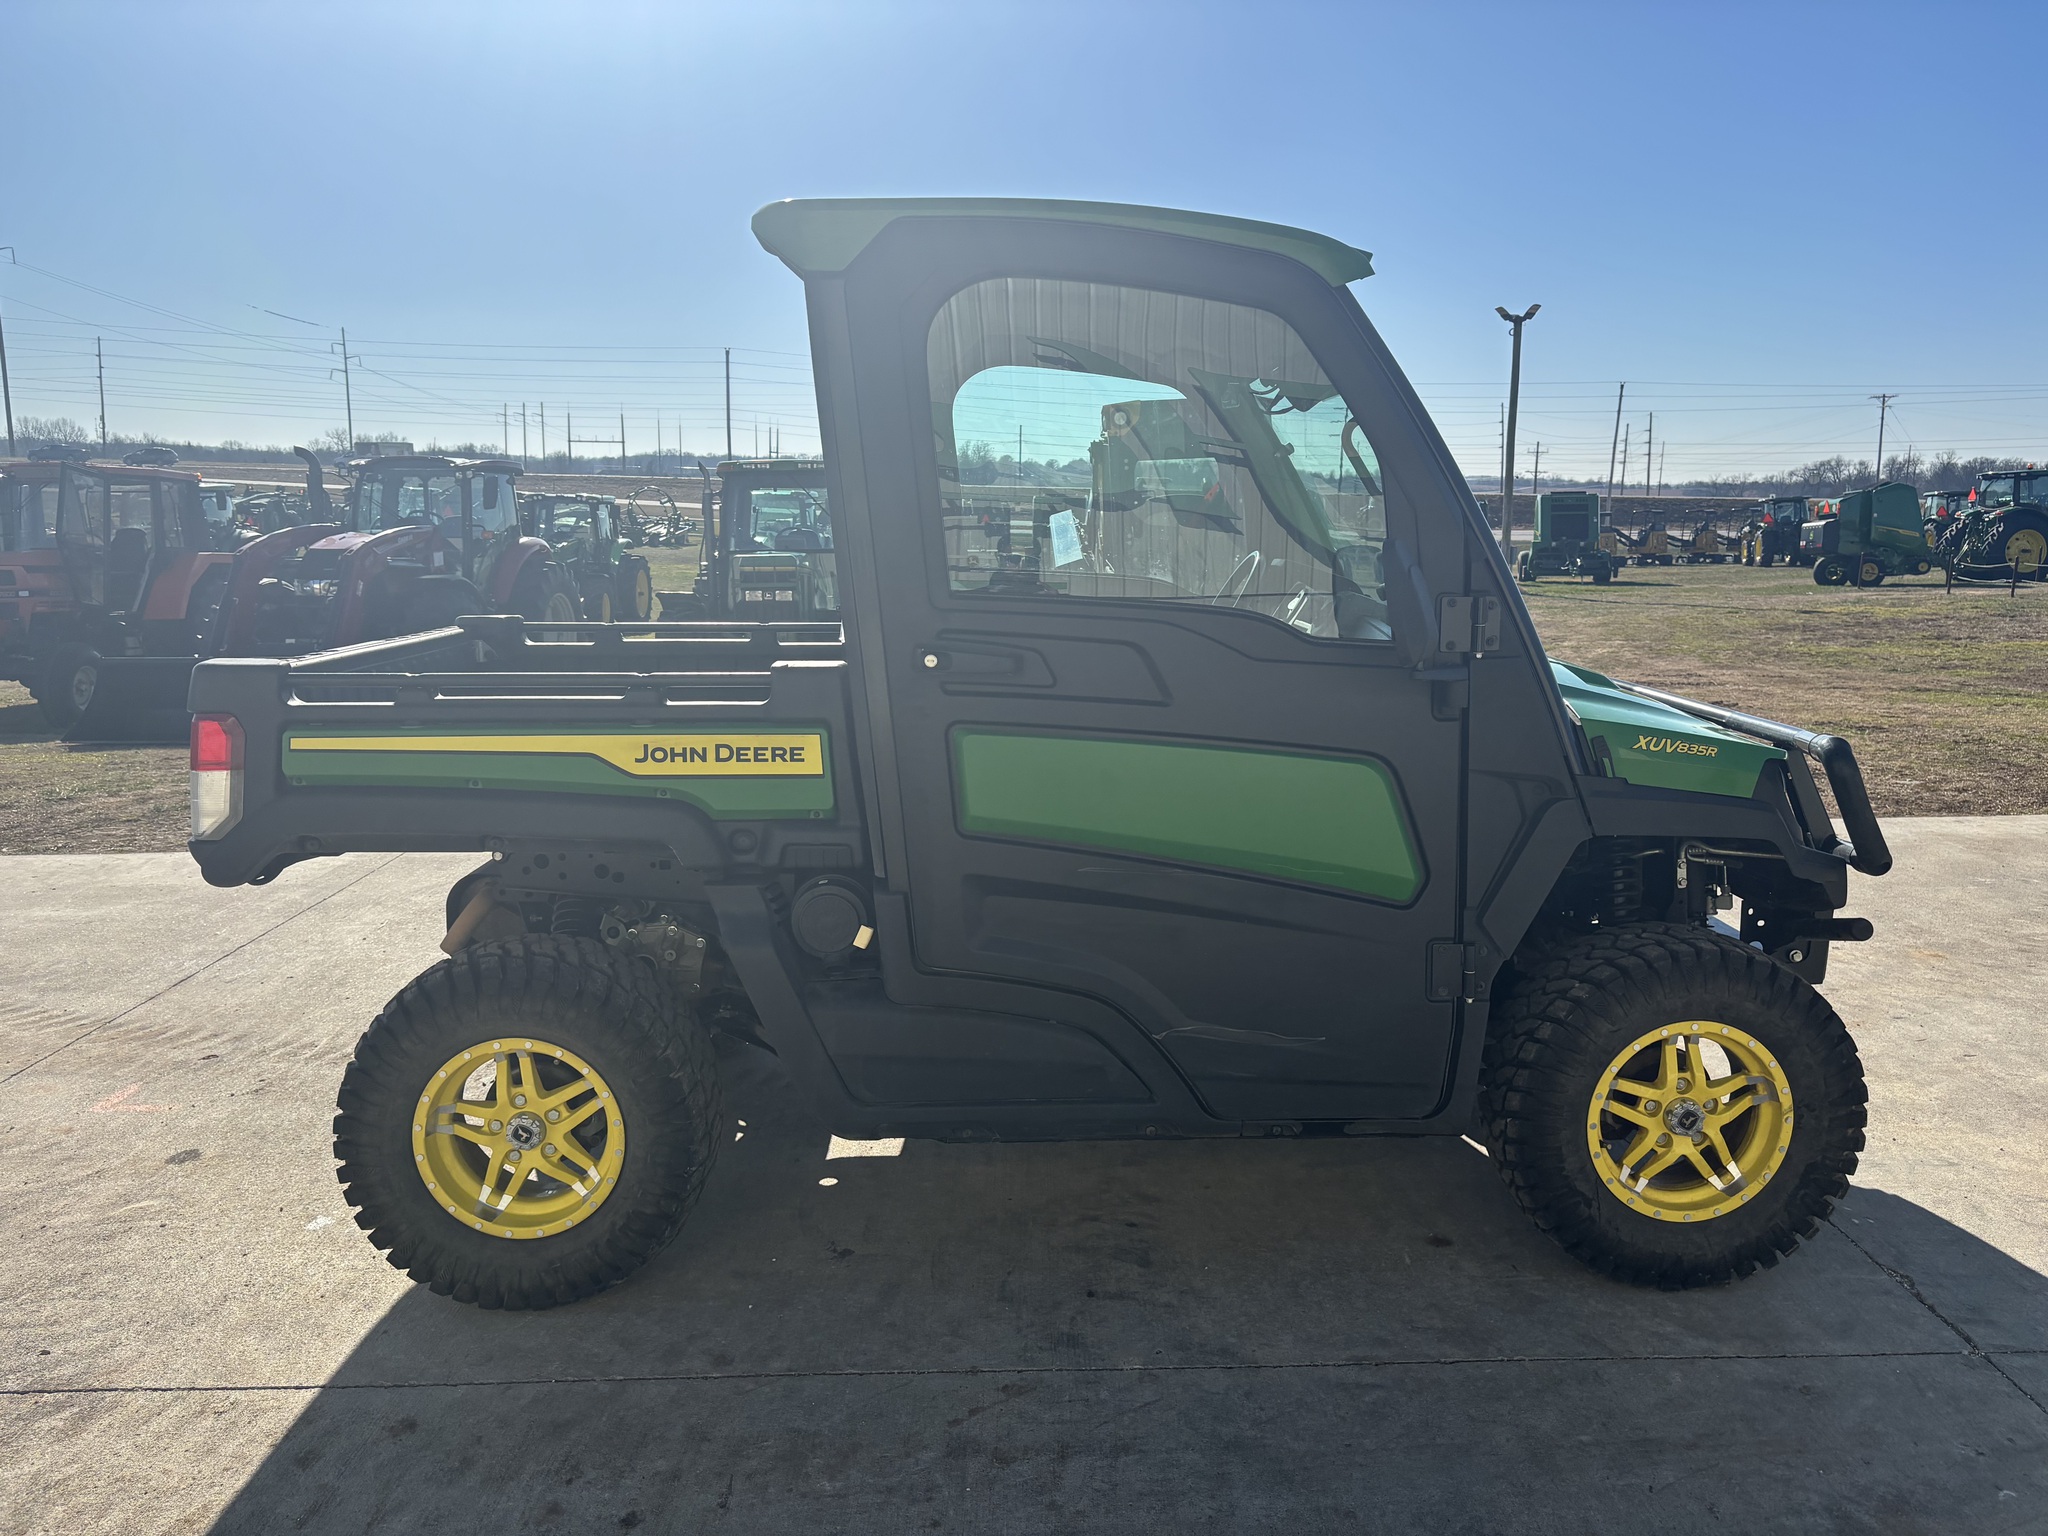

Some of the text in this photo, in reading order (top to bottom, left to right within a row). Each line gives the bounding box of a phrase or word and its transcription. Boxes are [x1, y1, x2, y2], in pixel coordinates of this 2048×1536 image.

[635, 744, 805, 763] JOHN DEERE
[1632, 735, 1718, 757] XUV835R
